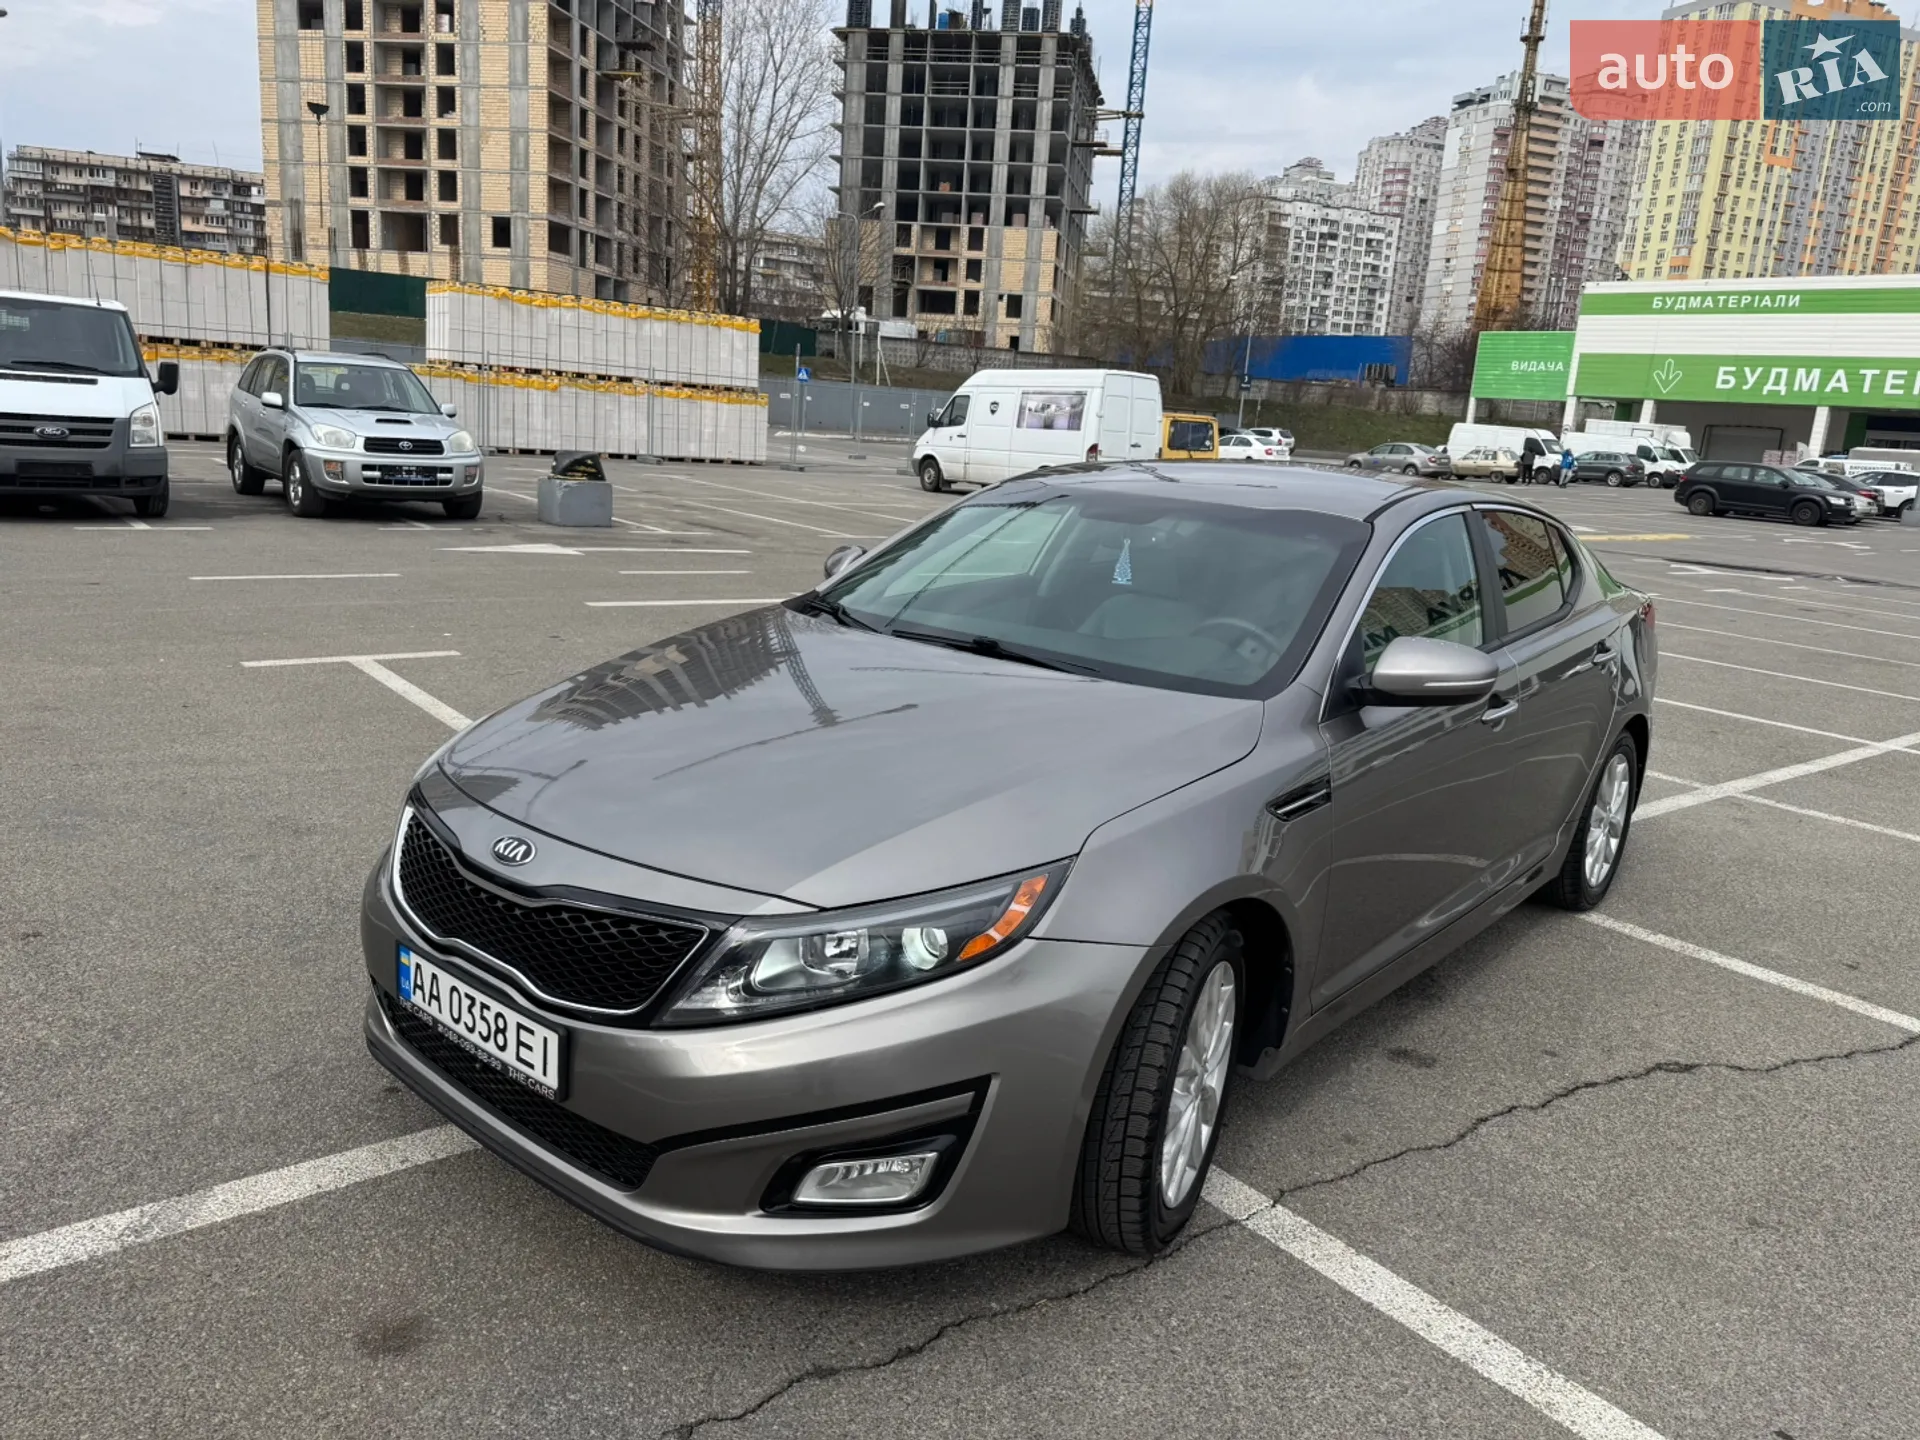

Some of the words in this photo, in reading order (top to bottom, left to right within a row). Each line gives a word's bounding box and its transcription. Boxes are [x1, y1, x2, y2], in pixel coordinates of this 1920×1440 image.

[1652, 294, 1801, 311] БУДМАТЕРІАЛИ
[1510, 360, 1565, 373] ВИДАЧА
[1715, 366, 1920, 396] БУДМАТЕ
[494, 837, 528, 861] KIA
[412, 962, 442, 1015] AA
[449, 985, 508, 1053] 0358
[515, 1021, 548, 1077] EI
[507, 1065, 527, 1085] THE
[527, 1077, 555, 1100] CARS
